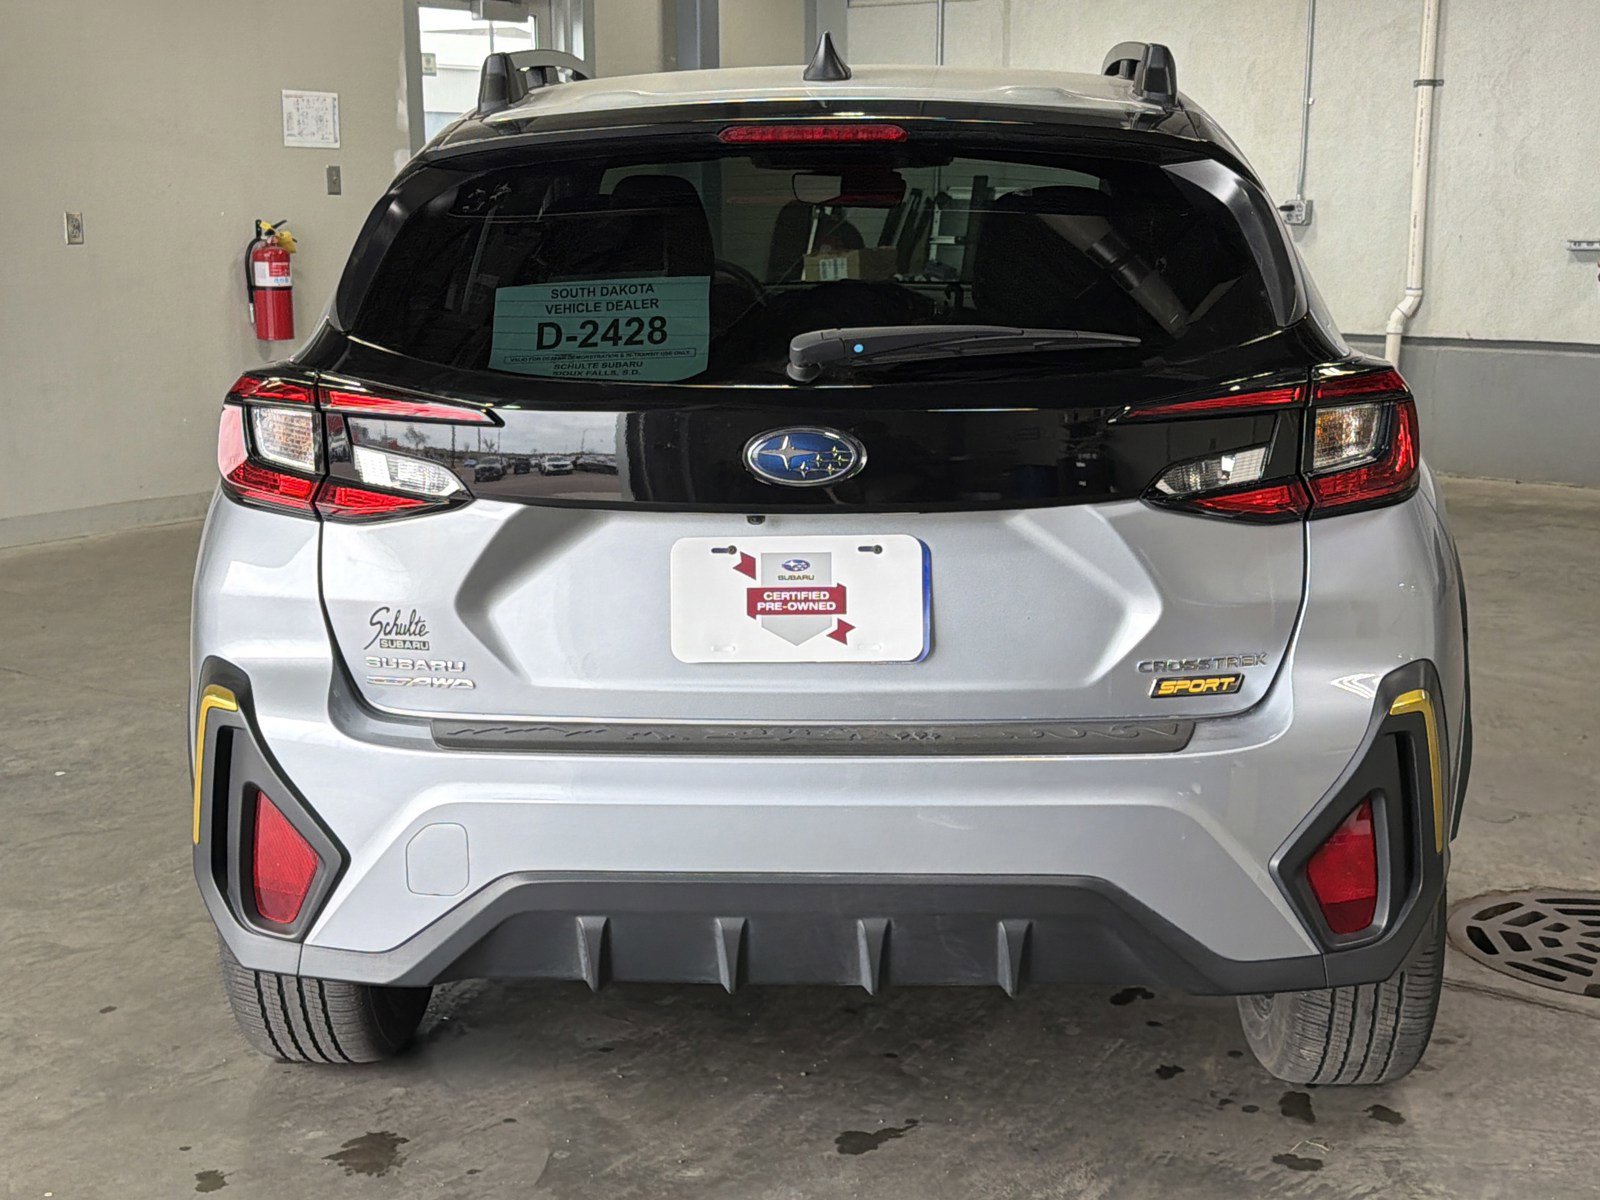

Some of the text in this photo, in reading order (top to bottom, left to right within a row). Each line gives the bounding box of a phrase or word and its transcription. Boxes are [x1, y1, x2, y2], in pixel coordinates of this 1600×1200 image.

[551, 284, 655, 300] SOUTH DAKOTA
[545, 299, 659, 315] VEHICLE DEALER
[536, 316, 668, 351] D-2428
[601, 361, 643, 369] SUBARU
[763, 591, 830, 601] CERTIFIED
[756, 601, 837, 611] PRE-OWNED
[364, 606, 430, 650] Schulte
[380, 639, 429, 650] SUBARU
[365, 656, 465, 673] SUBARU
[1136, 652, 1267, 674] CROSSTREK
[1157, 677, 1236, 696] SPORT
